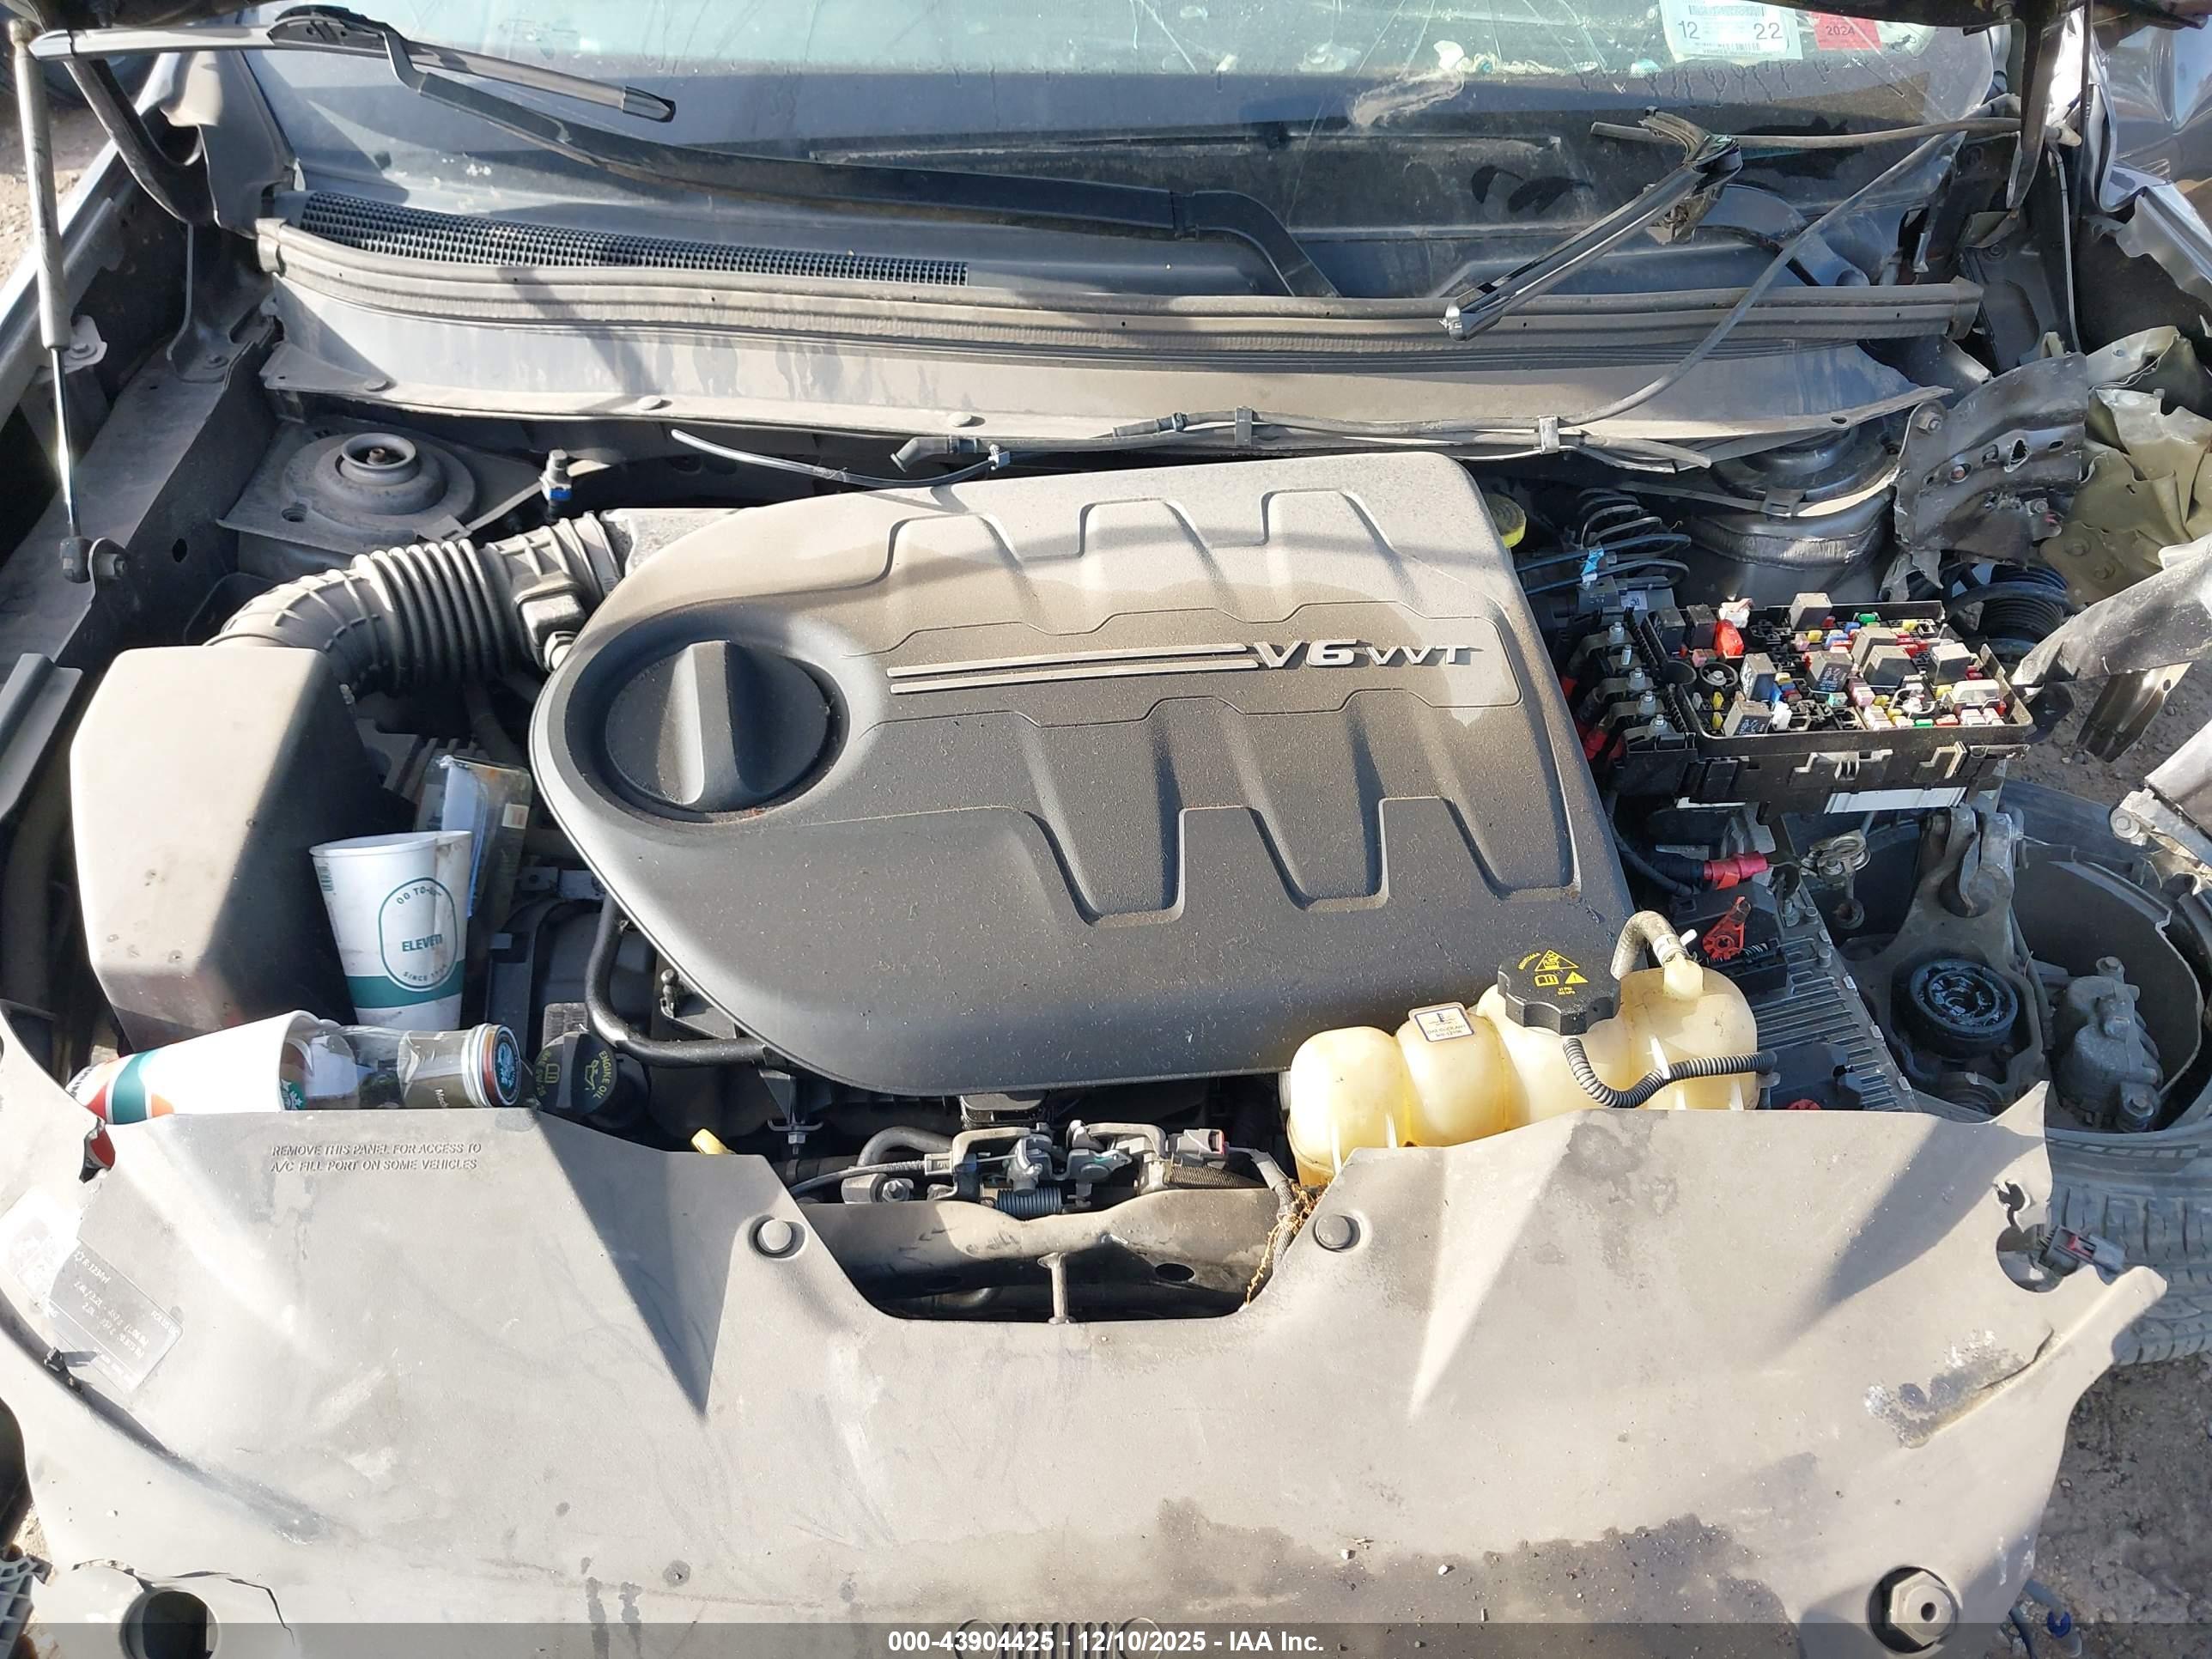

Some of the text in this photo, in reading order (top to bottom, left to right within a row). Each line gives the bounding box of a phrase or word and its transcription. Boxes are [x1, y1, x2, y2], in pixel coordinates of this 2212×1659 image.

[1677, 20, 1701, 40] 12
[1753, 21, 1784, 40] 22
[1254, 639, 1470, 670] V6 VVT
[592, 1050, 612, 1099] ENGINE OIL
[272, 1143, 482, 1156] REMOVE THIS PANEL FOR ACCESS TO
[270, 1159, 477, 1173] A/C FILL PORT ON SOME VEHICLES
